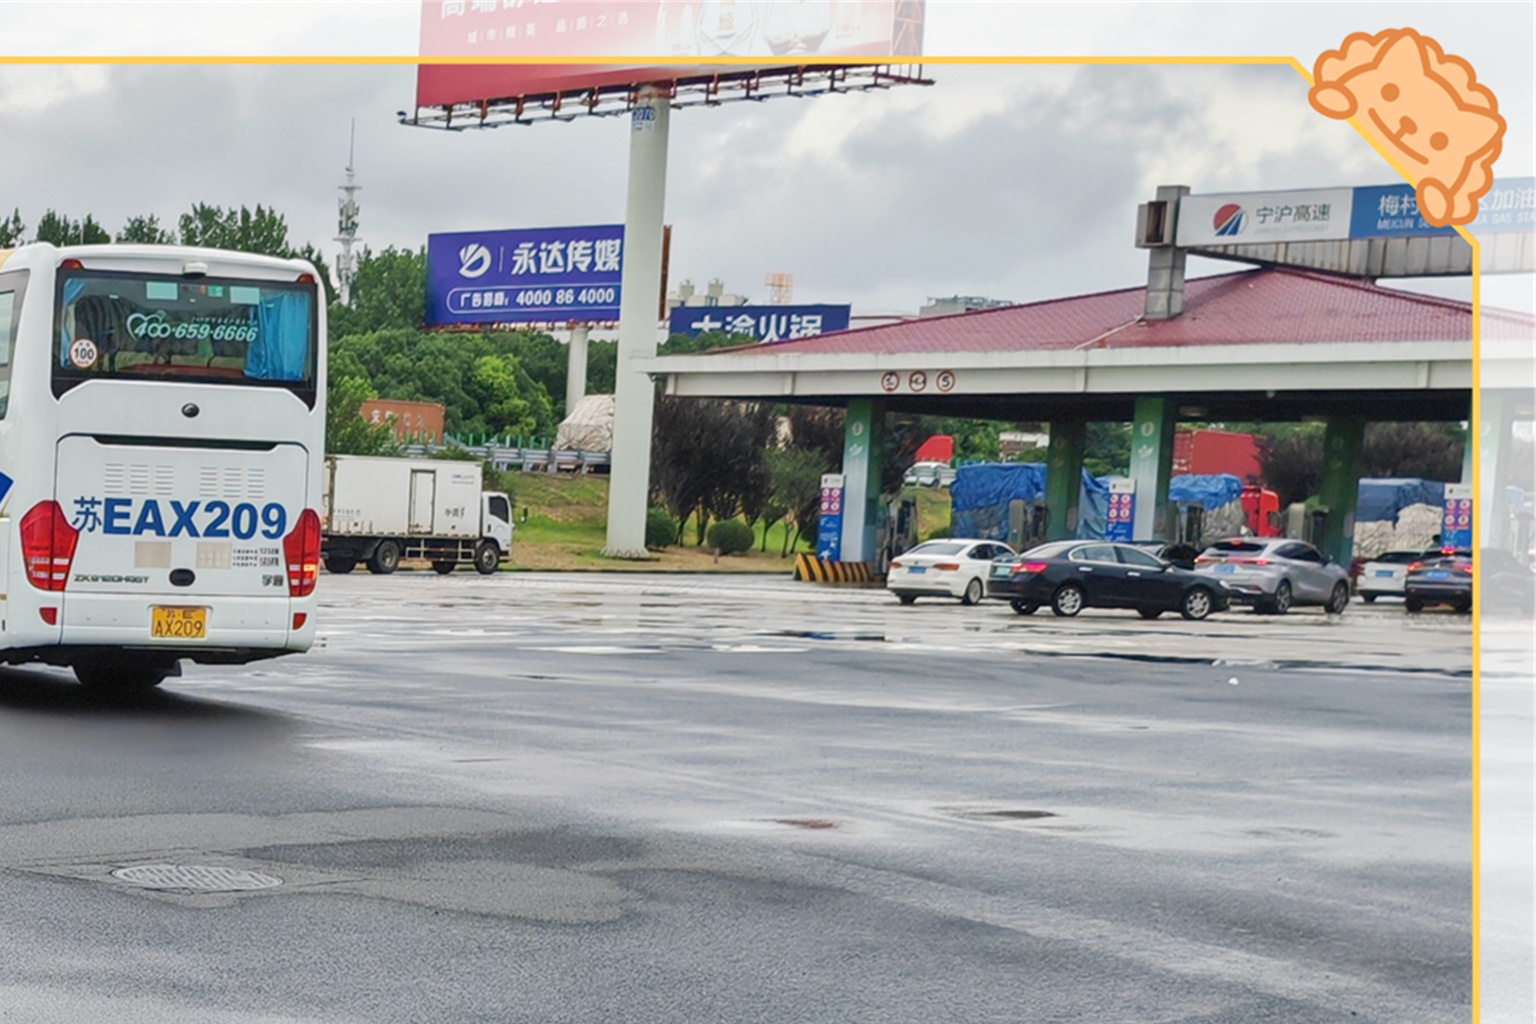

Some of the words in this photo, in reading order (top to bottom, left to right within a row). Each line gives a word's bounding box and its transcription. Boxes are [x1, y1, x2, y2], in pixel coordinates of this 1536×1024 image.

[1256, 203, 1331, 224] 宁沪高速
[511, 239, 621, 275] 永达传媒
[516, 290, 552, 305] 4000
[555, 289, 574, 304] 86
[578, 288, 615, 303] 4000
[74, 348, 95, 361] 100
[72, 496, 287, 540] 苏EAX209
[155, 619, 203, 637] AX209
